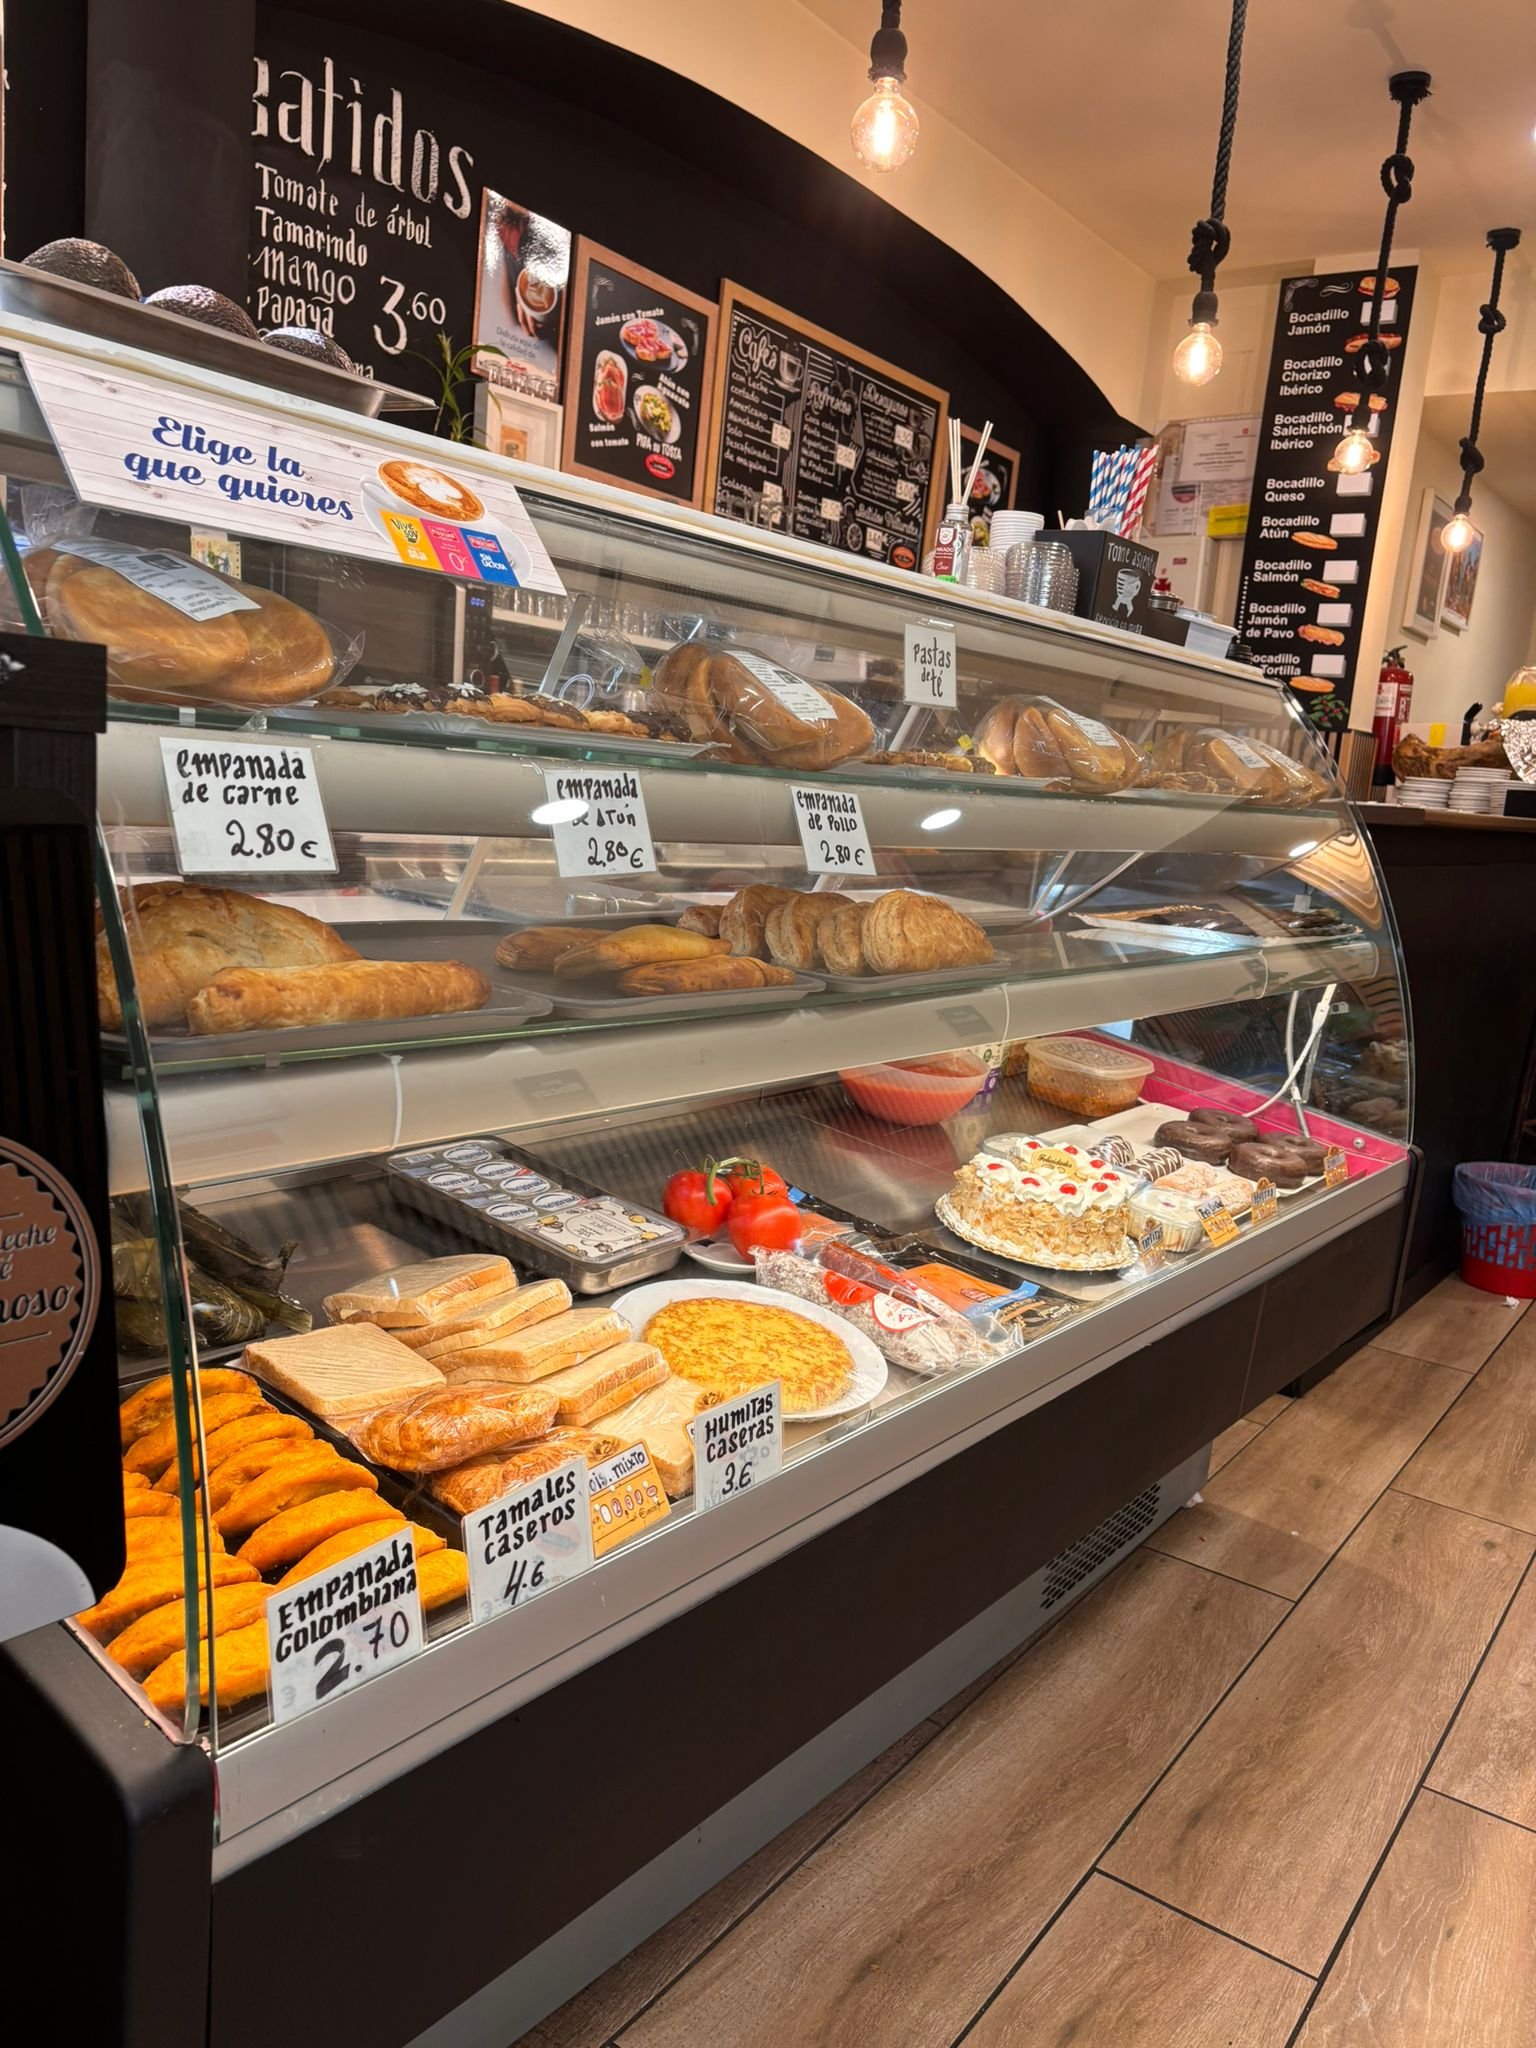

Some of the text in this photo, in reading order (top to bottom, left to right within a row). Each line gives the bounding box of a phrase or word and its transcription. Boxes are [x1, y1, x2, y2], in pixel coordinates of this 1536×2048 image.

[255, 162, 432, 248] Tomate de árbol
[255, 205, 368, 267] Tamarindo
[253, 246, 355, 305] Mango
[595, 306, 665, 327] Jamón con Tomate
[1289, 308, 1349, 324] Bocadillo
[1287, 322, 1331, 337] Jamón
[1283, 355, 1344, 371] Bocadillo
[1281, 369, 1331, 383] Chorizo
[1279, 383, 1324, 397] Ibérico
[1274, 411, 1334, 426] Bocadillo
[589, 421, 615, 433] Salmón
[1272, 422, 1343, 438] Salchichón
[151, 416, 306, 478] Elige la
[590, 437, 630, 449] con tomate
[1270, 438, 1314, 451] Ibérico
[123, 452, 354, 521] que quieres
[1266, 476, 1326, 490] Bocadillo
[1264, 491, 1306, 503] Queso
[1261, 515, 1320, 528] Bocadillo
[1259, 527, 1290, 540] Atún
[1254, 559, 1313, 572] Bocadillo
[1252, 571, 1299, 583] Salmón
[1249, 602, 1307, 615] Bocadillo
[1247, 614, 1288, 627] Jamón
[1245, 627, 1295, 640] de Pavo
[913, 636, 951, 669] Pastas
[921, 667, 930, 682] de
[1259, 664, 1302, 677] Tortilla
[176, 748, 307, 780] empanada
[182, 781, 300, 806] de carne
[556, 772, 638, 800] empanada
[796, 790, 857, 814] empanada
[808, 812, 858, 833] de Pollo
[704, 1392, 774, 1444] Humitas
[705, 1415, 774, 1464] caseras
[478, 1470, 576, 1542] Tamales
[484, 1498, 576, 1565] caseros
[278, 1539, 414, 1634] Empanada
[275, 1568, 417, 1663] Colombiana
